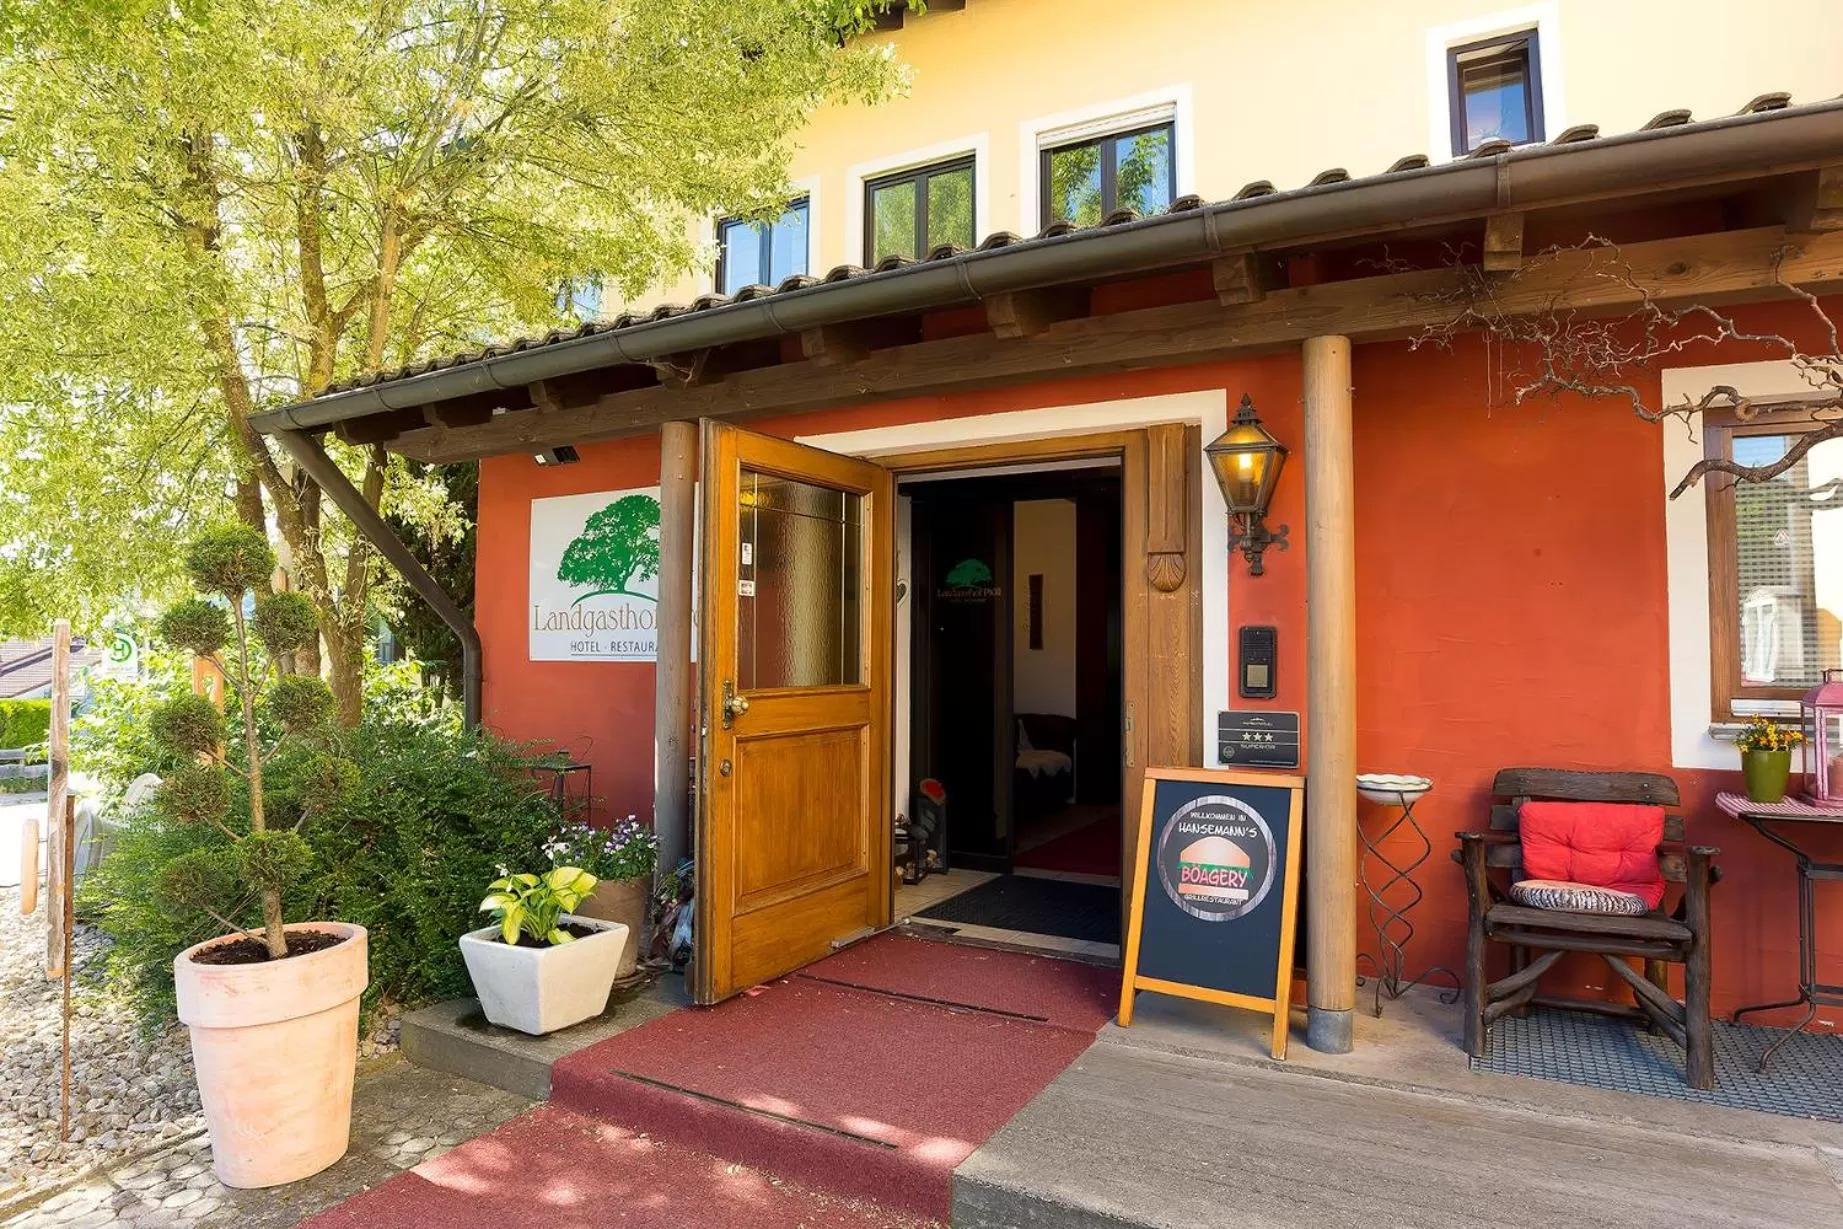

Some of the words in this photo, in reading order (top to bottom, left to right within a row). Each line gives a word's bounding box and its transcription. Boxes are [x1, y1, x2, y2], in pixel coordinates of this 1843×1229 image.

[534, 603, 658, 637] Landgastho
[571, 641, 600, 653] HOTEL
[1190, 811, 1236, 821] WILLKOMMEN
[1238, 814, 1247, 822] IN
[1178, 822, 1258, 838] HANSEMANN'S
[1181, 864, 1248, 888] BÖAGERY
